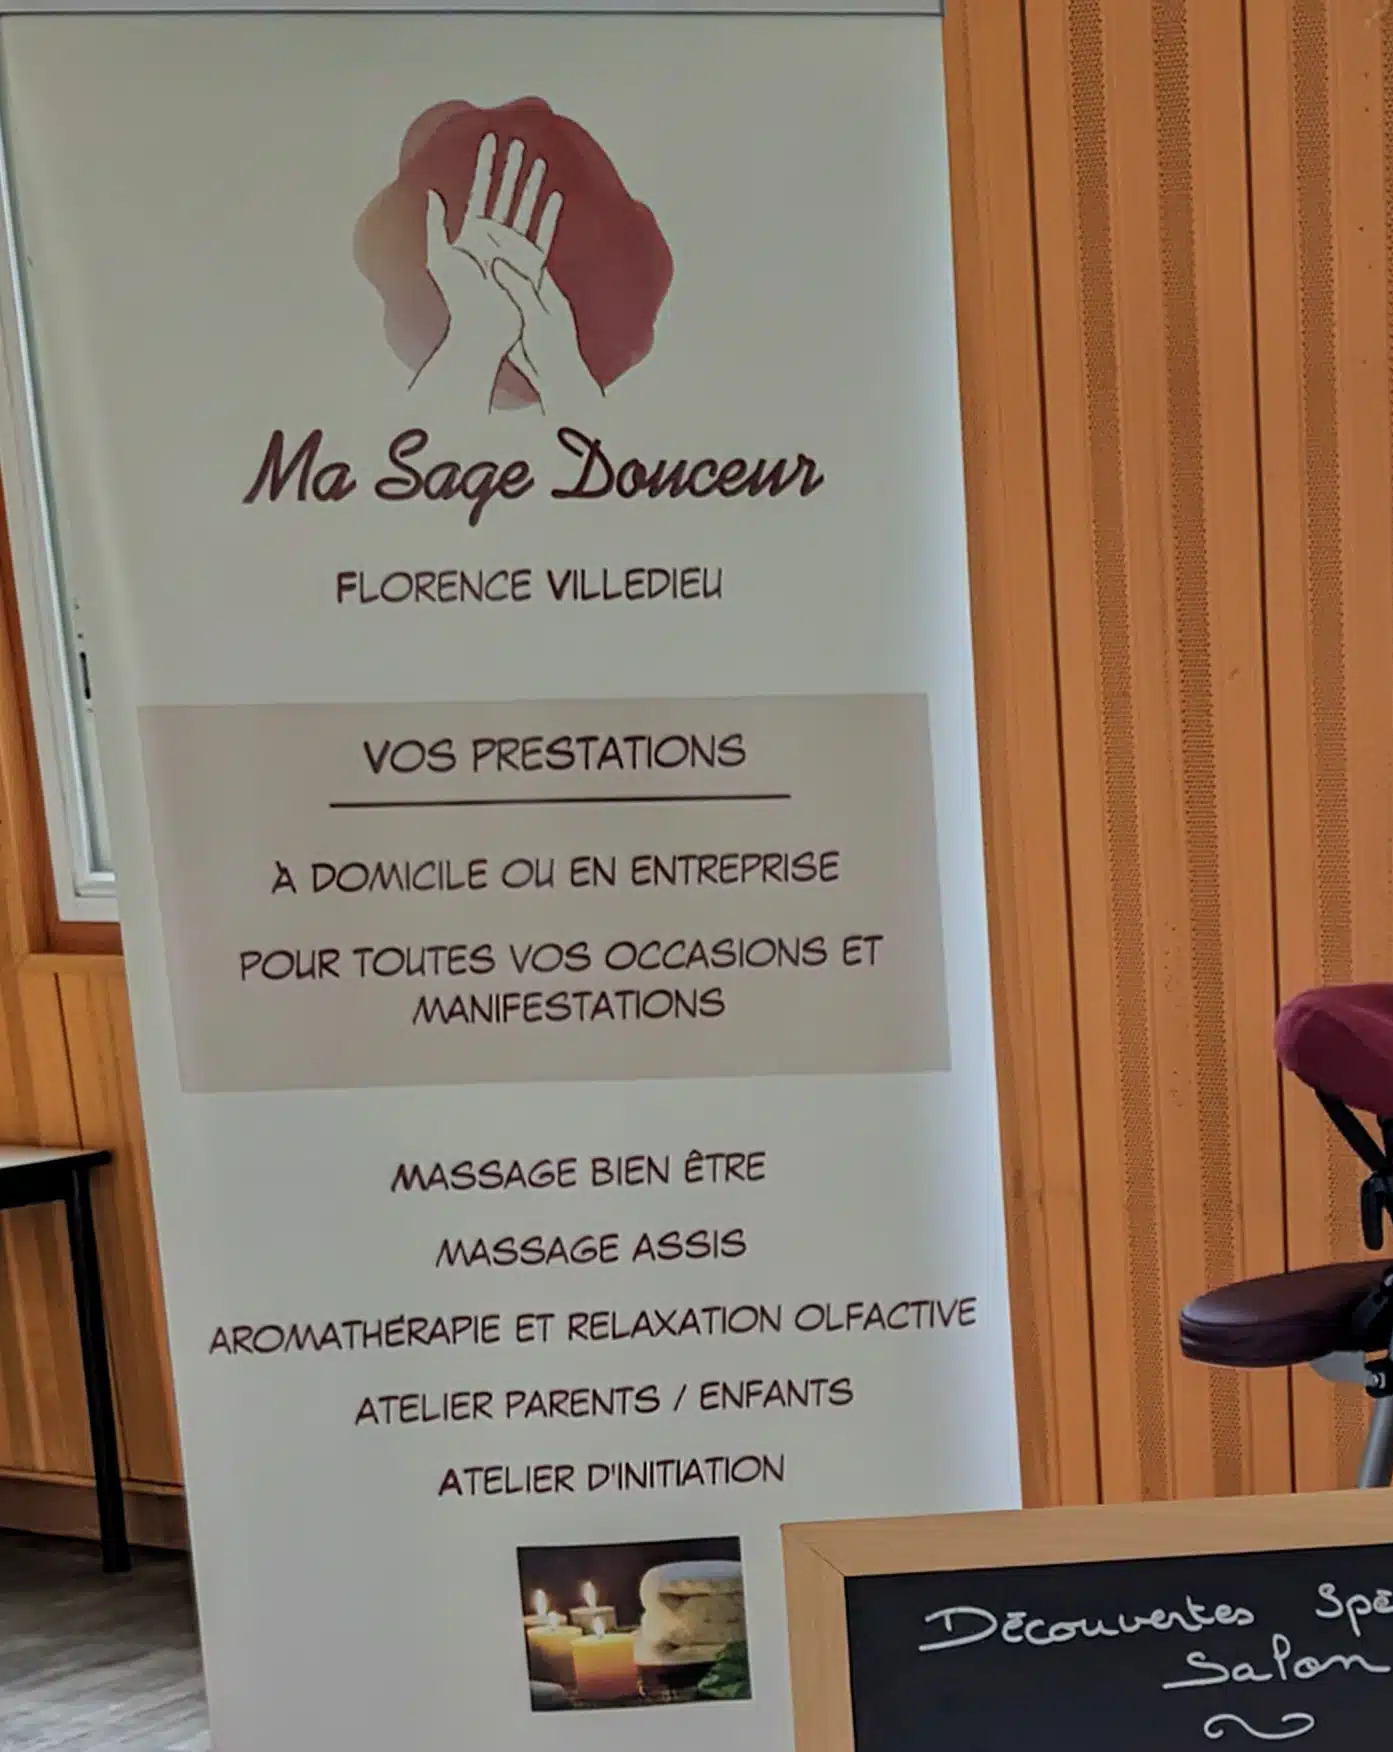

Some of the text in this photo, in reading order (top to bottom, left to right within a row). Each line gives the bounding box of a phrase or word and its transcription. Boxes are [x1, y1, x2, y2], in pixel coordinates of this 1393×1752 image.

[243, 427, 824, 527] Ma Sage Douceur
[337, 566, 722, 604] FLORENCE VILLEDIEU
[363, 734, 745, 774] VOS PRESTATIONS
[272, 851, 839, 894] À DOMICILE OU EN ENTREPRISE
[240, 935, 884, 981] POUR TOUTES VOS OCCASIONS ET
[412, 987, 725, 1025] MANIFESTATIONS
[390, 1149, 766, 1192] MASSAGE BIEN ÊTRE
[436, 1228, 747, 1268] MASSAGE ASSIS
[209, 1297, 976, 1354] AROMATHÉRAPIE ET RELAXATION OLFACTIVE
[354, 1377, 853, 1426] ATELIER PARENTS / ENFANTS
[438, 1454, 784, 1496] ATELIER D'INITIATION
[1162, 1634, 1391, 1689] Salon
